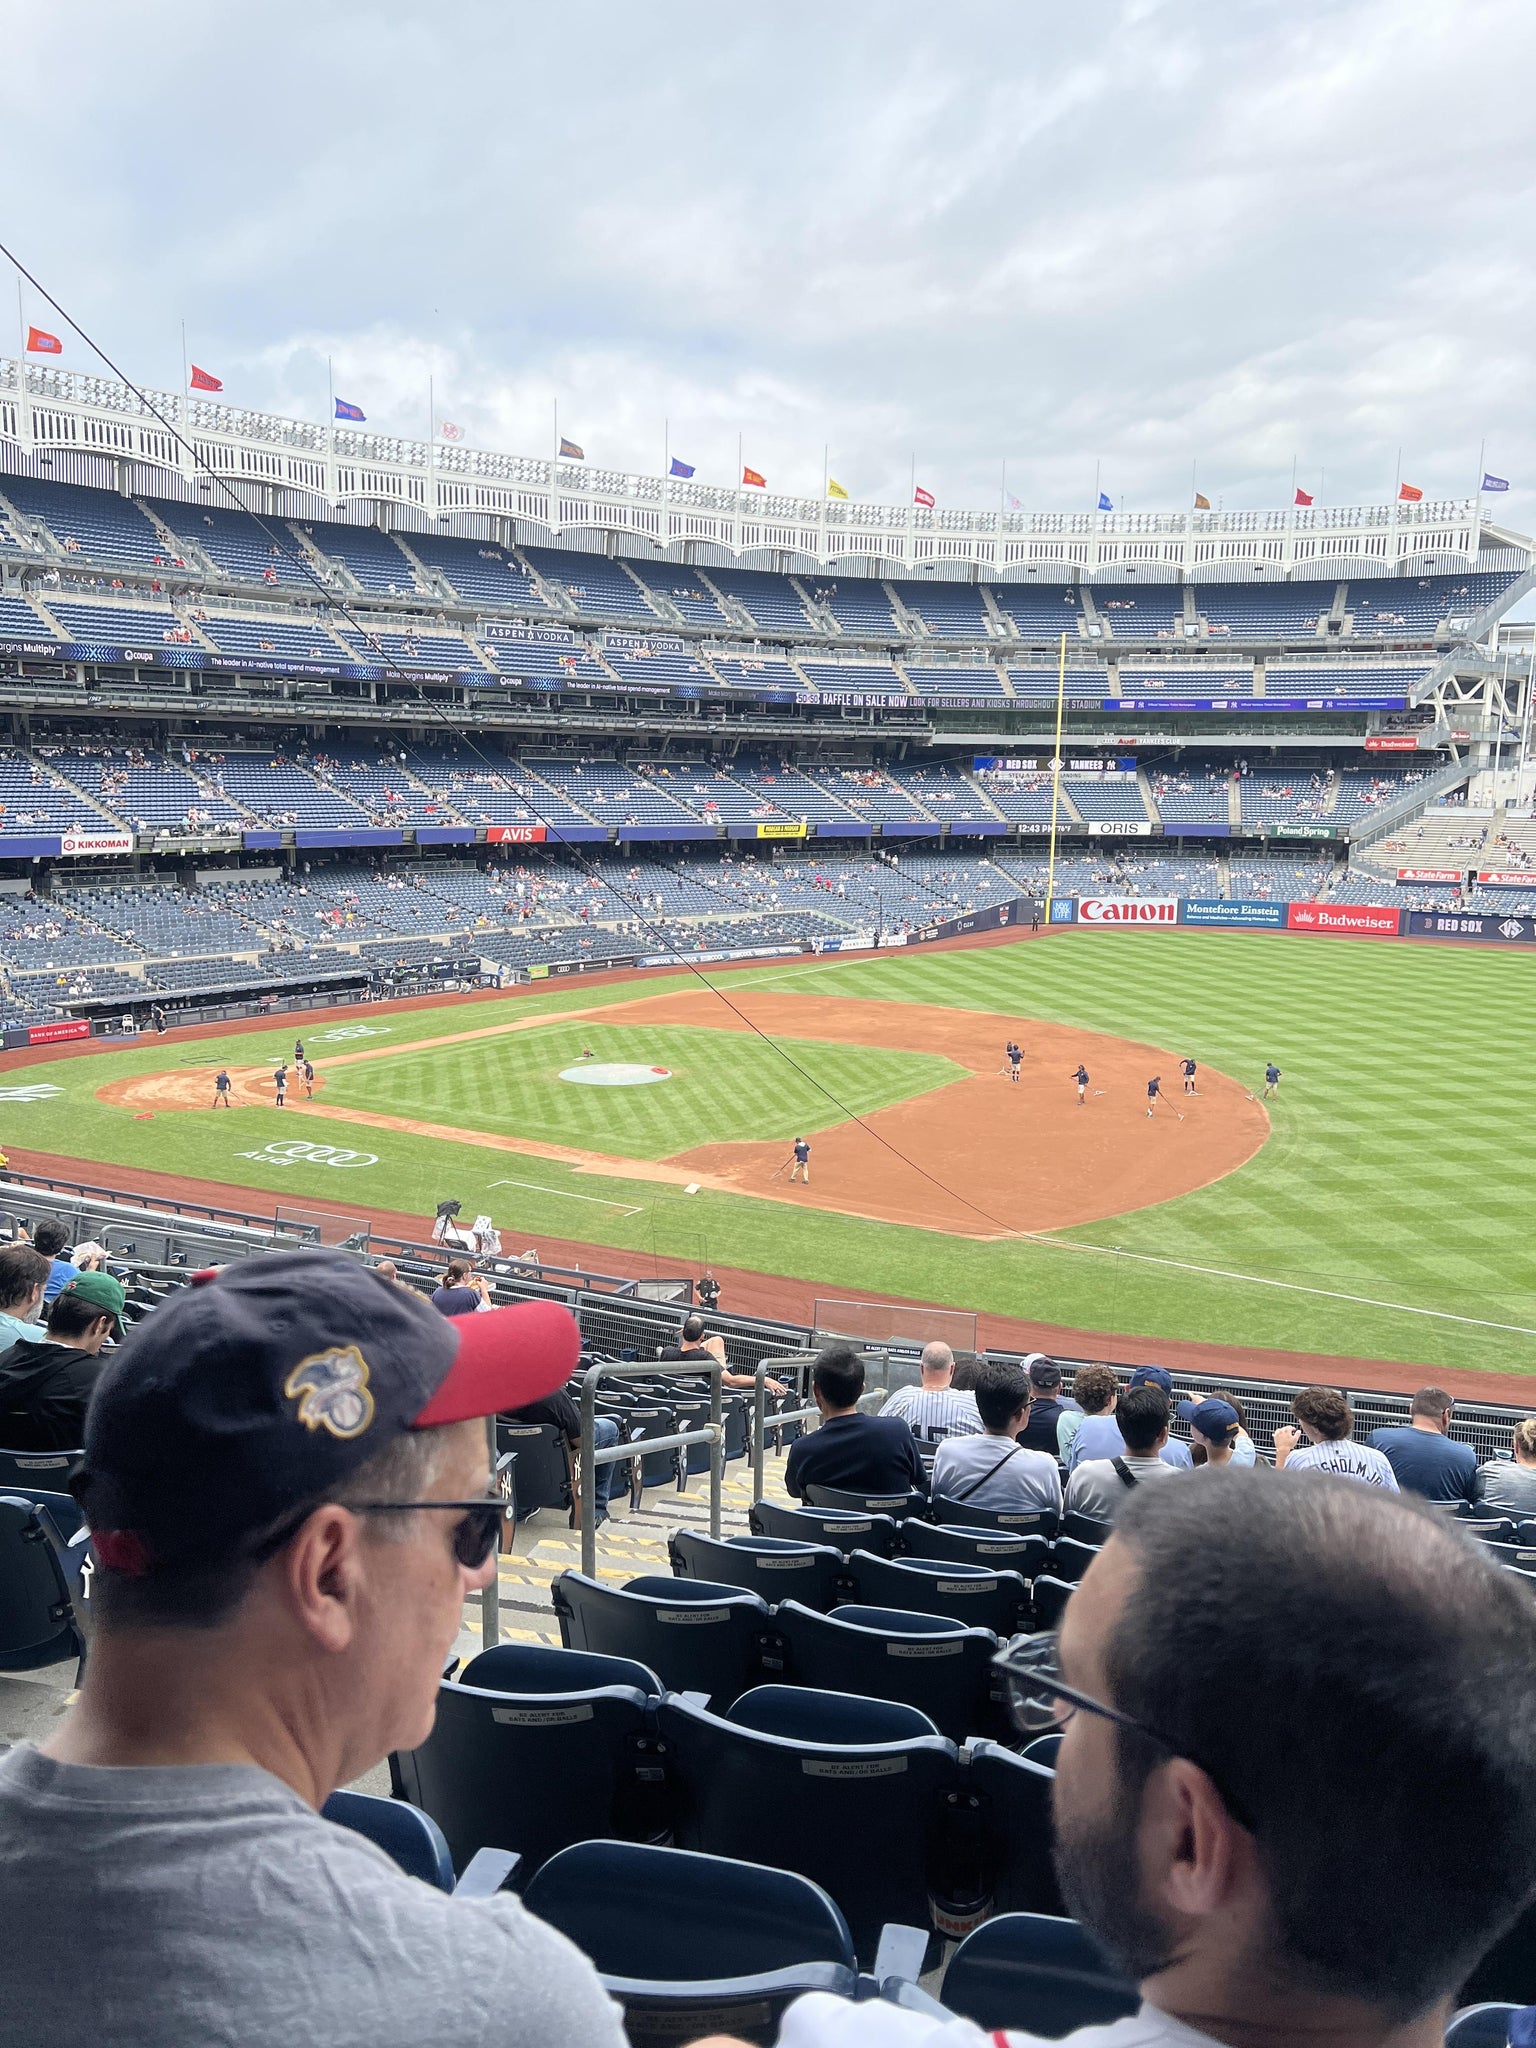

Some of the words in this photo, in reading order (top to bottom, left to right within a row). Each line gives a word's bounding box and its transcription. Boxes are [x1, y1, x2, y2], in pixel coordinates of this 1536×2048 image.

[490, 627, 524, 639] ASPEN
[536, 632, 570, 643] VODKA
[0, 642, 22, 654] argins
[609, 638, 640, 648] ASPEN
[650, 642, 680, 651] VODKA
[132, 652, 154, 662] coupa
[210, 658, 222, 666] The
[222, 658, 240, 667] leader
[248, 660, 274, 669] AI-native
[274, 662, 286, 670] total
[287, 663, 304, 672] spend
[305, 665, 340, 675] management
[386, 670, 400, 678] Make
[506, 678, 522, 686] coupa
[576, 682, 590, 690] leader
[628, 686, 641, 694] spend
[642, 687, 670, 695] management
[822, 694, 850, 706] RAFFLE
[853, 694, 864, 706] ON
[866, 695, 886, 707] SALE
[888, 696, 908, 708] NOW
[909, 697, 926, 707] LOOK
[927, 698, 940, 707] FOR
[941, 698, 970, 708] SELLERS
[971, 699, 984, 708] AND
[986, 699, 1010, 708] KIOSKS
[1012, 700, 1054, 708] THROUGHOUT
[1071, 700, 1100, 709] STADIUM
[1380, 740, 1415, 748] Budweiser
[1006, 760, 1021, 770] RED
[1022, 760, 1038, 770] SOX
[1070, 760, 1104, 770] YANKEES
[501, 828, 532, 841] AVIS
[1018, 824, 1040, 833] 12:43
[1100, 823, 1138, 834] ORIS
[1276, 826, 1303, 836] Poland
[1304, 826, 1330, 838] Spring
[78, 840, 129, 849] KIKKOMAN
[1080, 900, 1174, 920] Canon
[1186, 904, 1238, 914] Montefiore
[1241, 905, 1279, 916] Einstein
[1318, 912, 1394, 929] Budweiser
[1437, 918, 1458, 932] RED
[1460, 920, 1482, 933] SOX
[1503, 922, 1519, 936] VS
[233, 1151, 300, 1166] Audi
[1321, 1458, 1366, 1478] SHOLM
